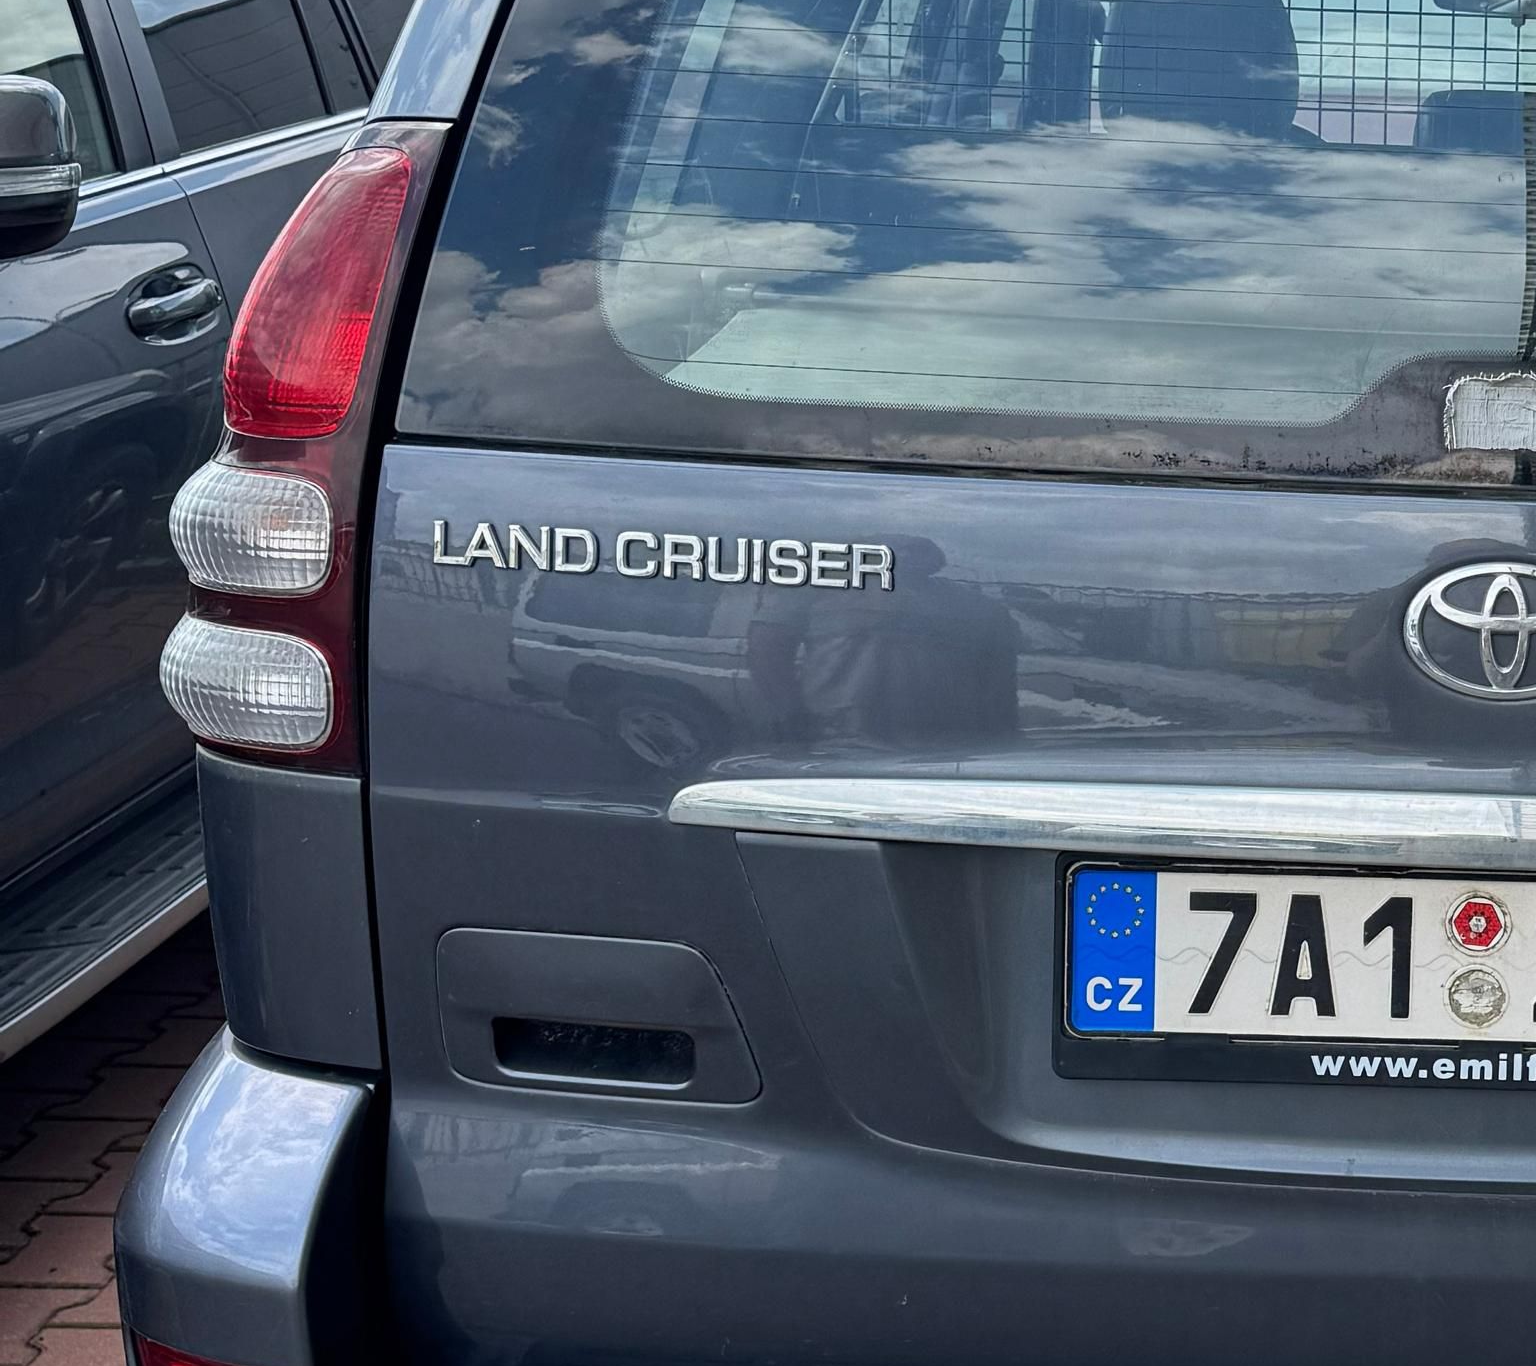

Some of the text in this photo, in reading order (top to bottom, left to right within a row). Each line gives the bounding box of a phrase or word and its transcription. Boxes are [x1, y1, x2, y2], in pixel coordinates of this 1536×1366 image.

[432, 519, 895, 591] LAND CRUISER
[1186, 891, 1414, 1020] 7A1
[1085, 976, 1144, 1013] CZ
